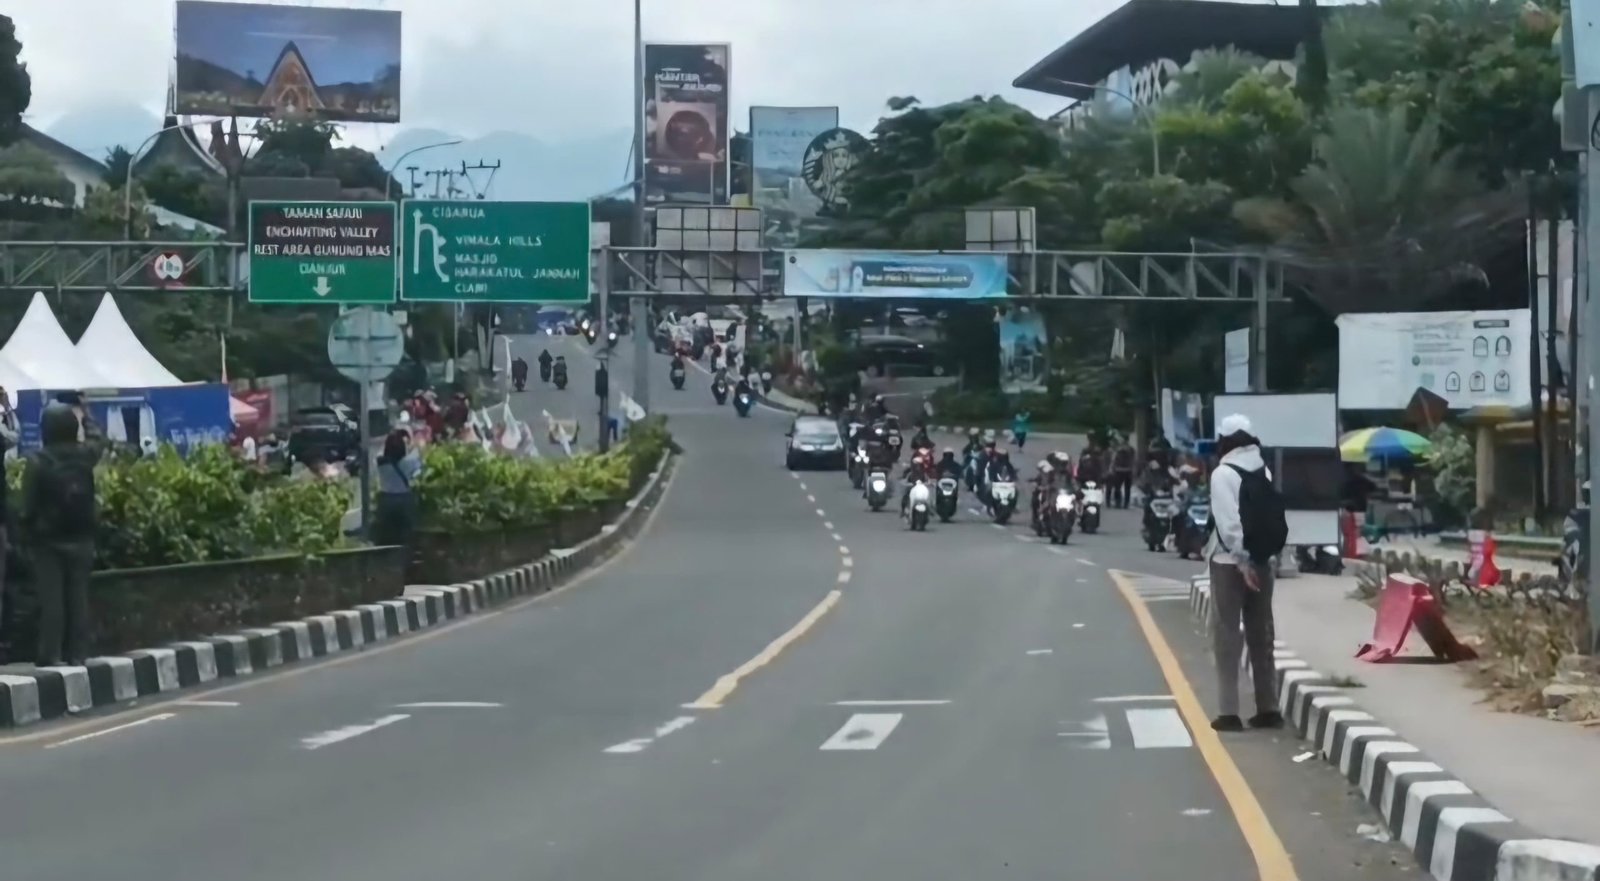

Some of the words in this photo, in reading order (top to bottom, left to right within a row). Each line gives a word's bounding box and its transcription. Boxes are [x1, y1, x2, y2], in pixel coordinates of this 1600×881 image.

[340, 227, 379, 238] VALLEY
[254, 244, 279, 256] REST
[282, 244, 311, 256] AREA
[366, 246, 390, 257] MAS
[454, 253, 498, 265] MASJID
